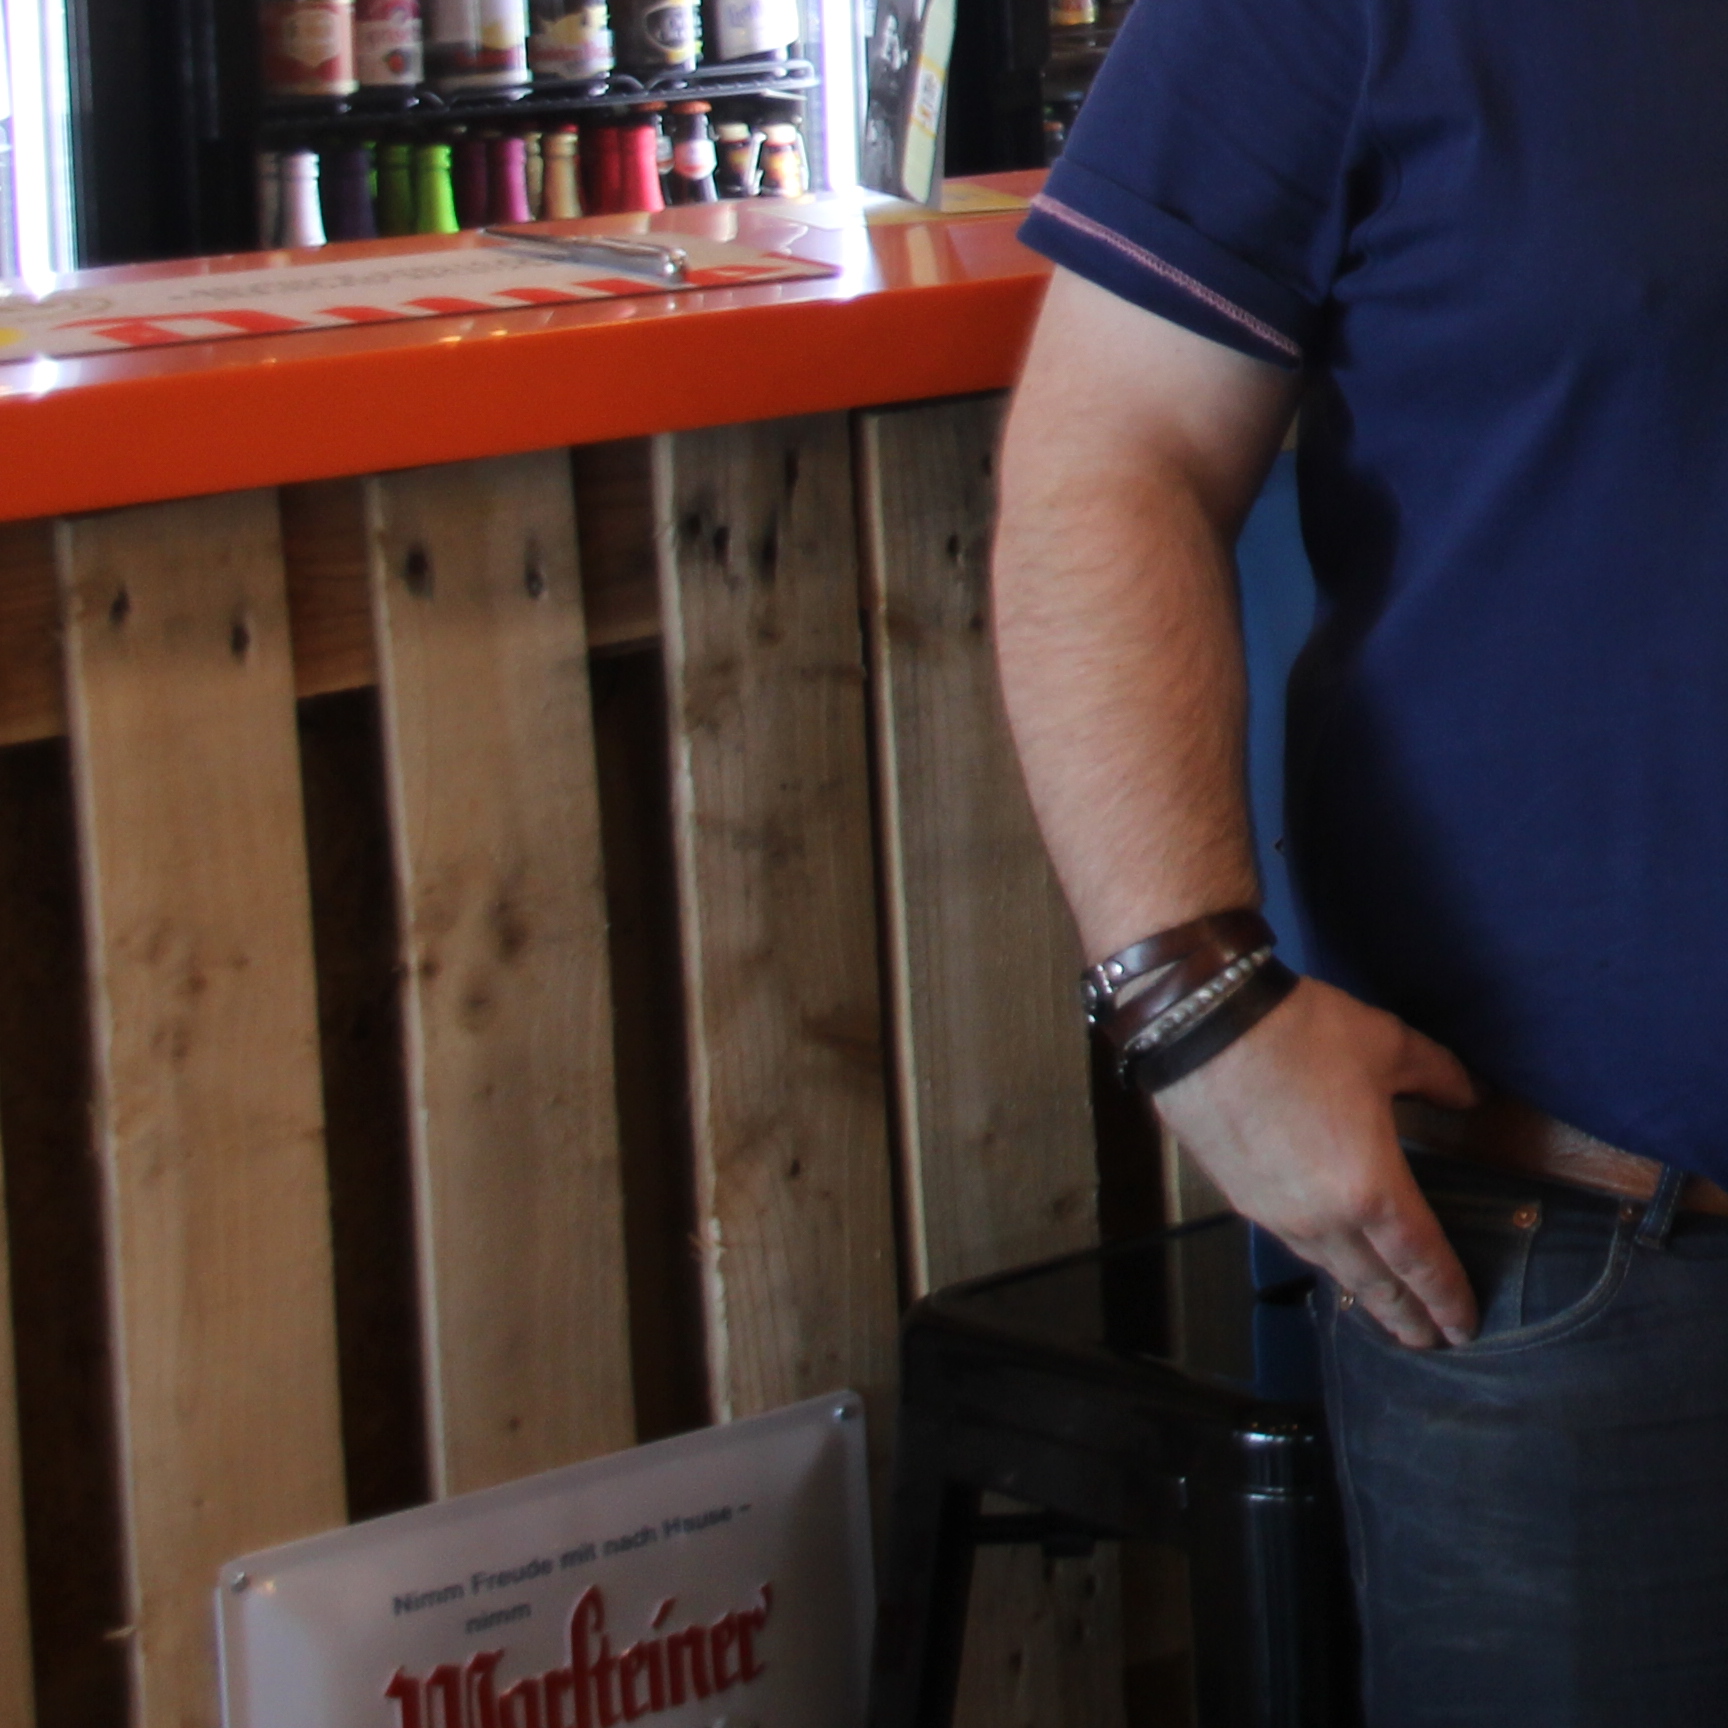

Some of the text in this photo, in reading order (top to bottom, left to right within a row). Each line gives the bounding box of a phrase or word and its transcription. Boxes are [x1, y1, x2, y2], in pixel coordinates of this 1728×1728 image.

[470, 1557, 554, 1595] Freude
[559, 1542, 596, 1570] mit
[602, 1525, 658, 1557] nach
[661, 1505, 733, 1539] Hause
